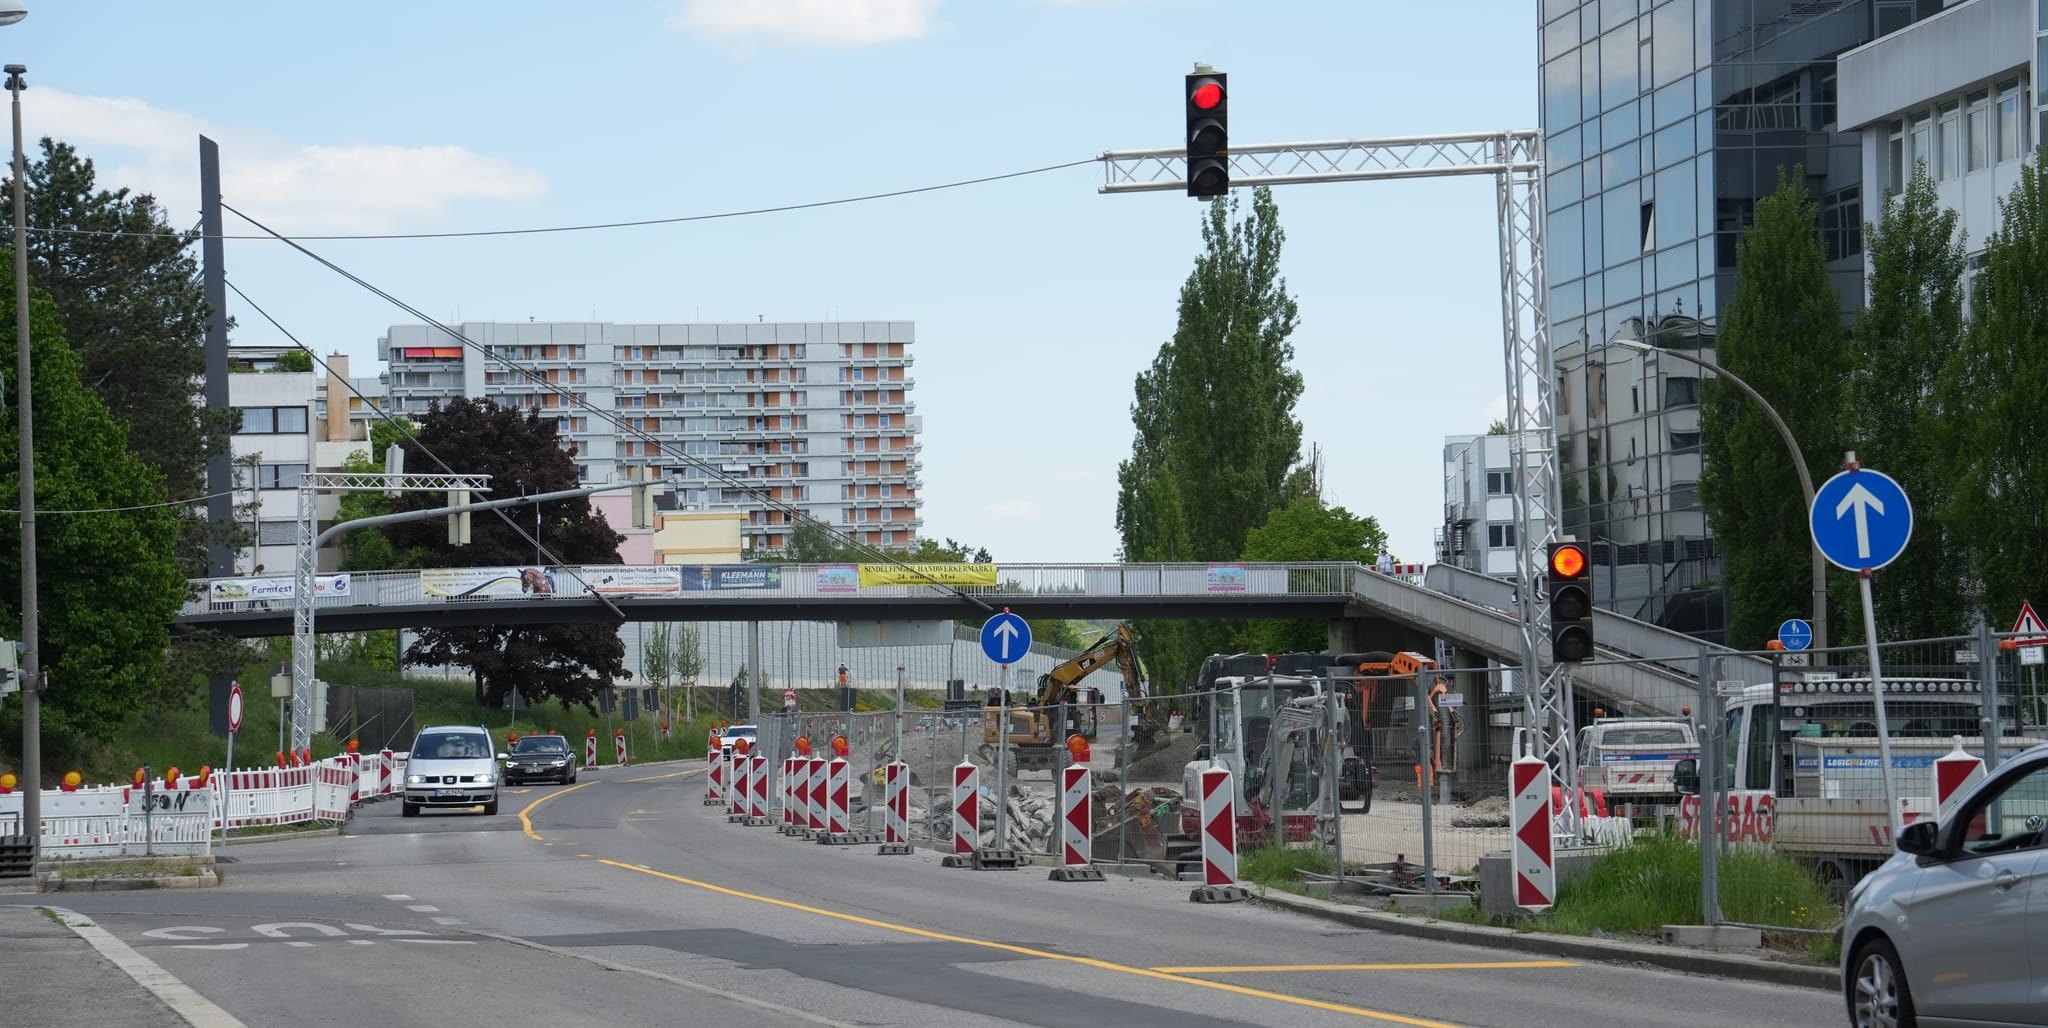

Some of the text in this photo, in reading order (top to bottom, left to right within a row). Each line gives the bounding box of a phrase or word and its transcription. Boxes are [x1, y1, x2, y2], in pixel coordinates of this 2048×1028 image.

[864, 565, 914, 573] SINDELFINGER
[917, 565, 993, 573] HANDWERKERMARKT
[721, 571, 766, 579] KLEEMANN
[251, 585, 292, 594] Farmfest
